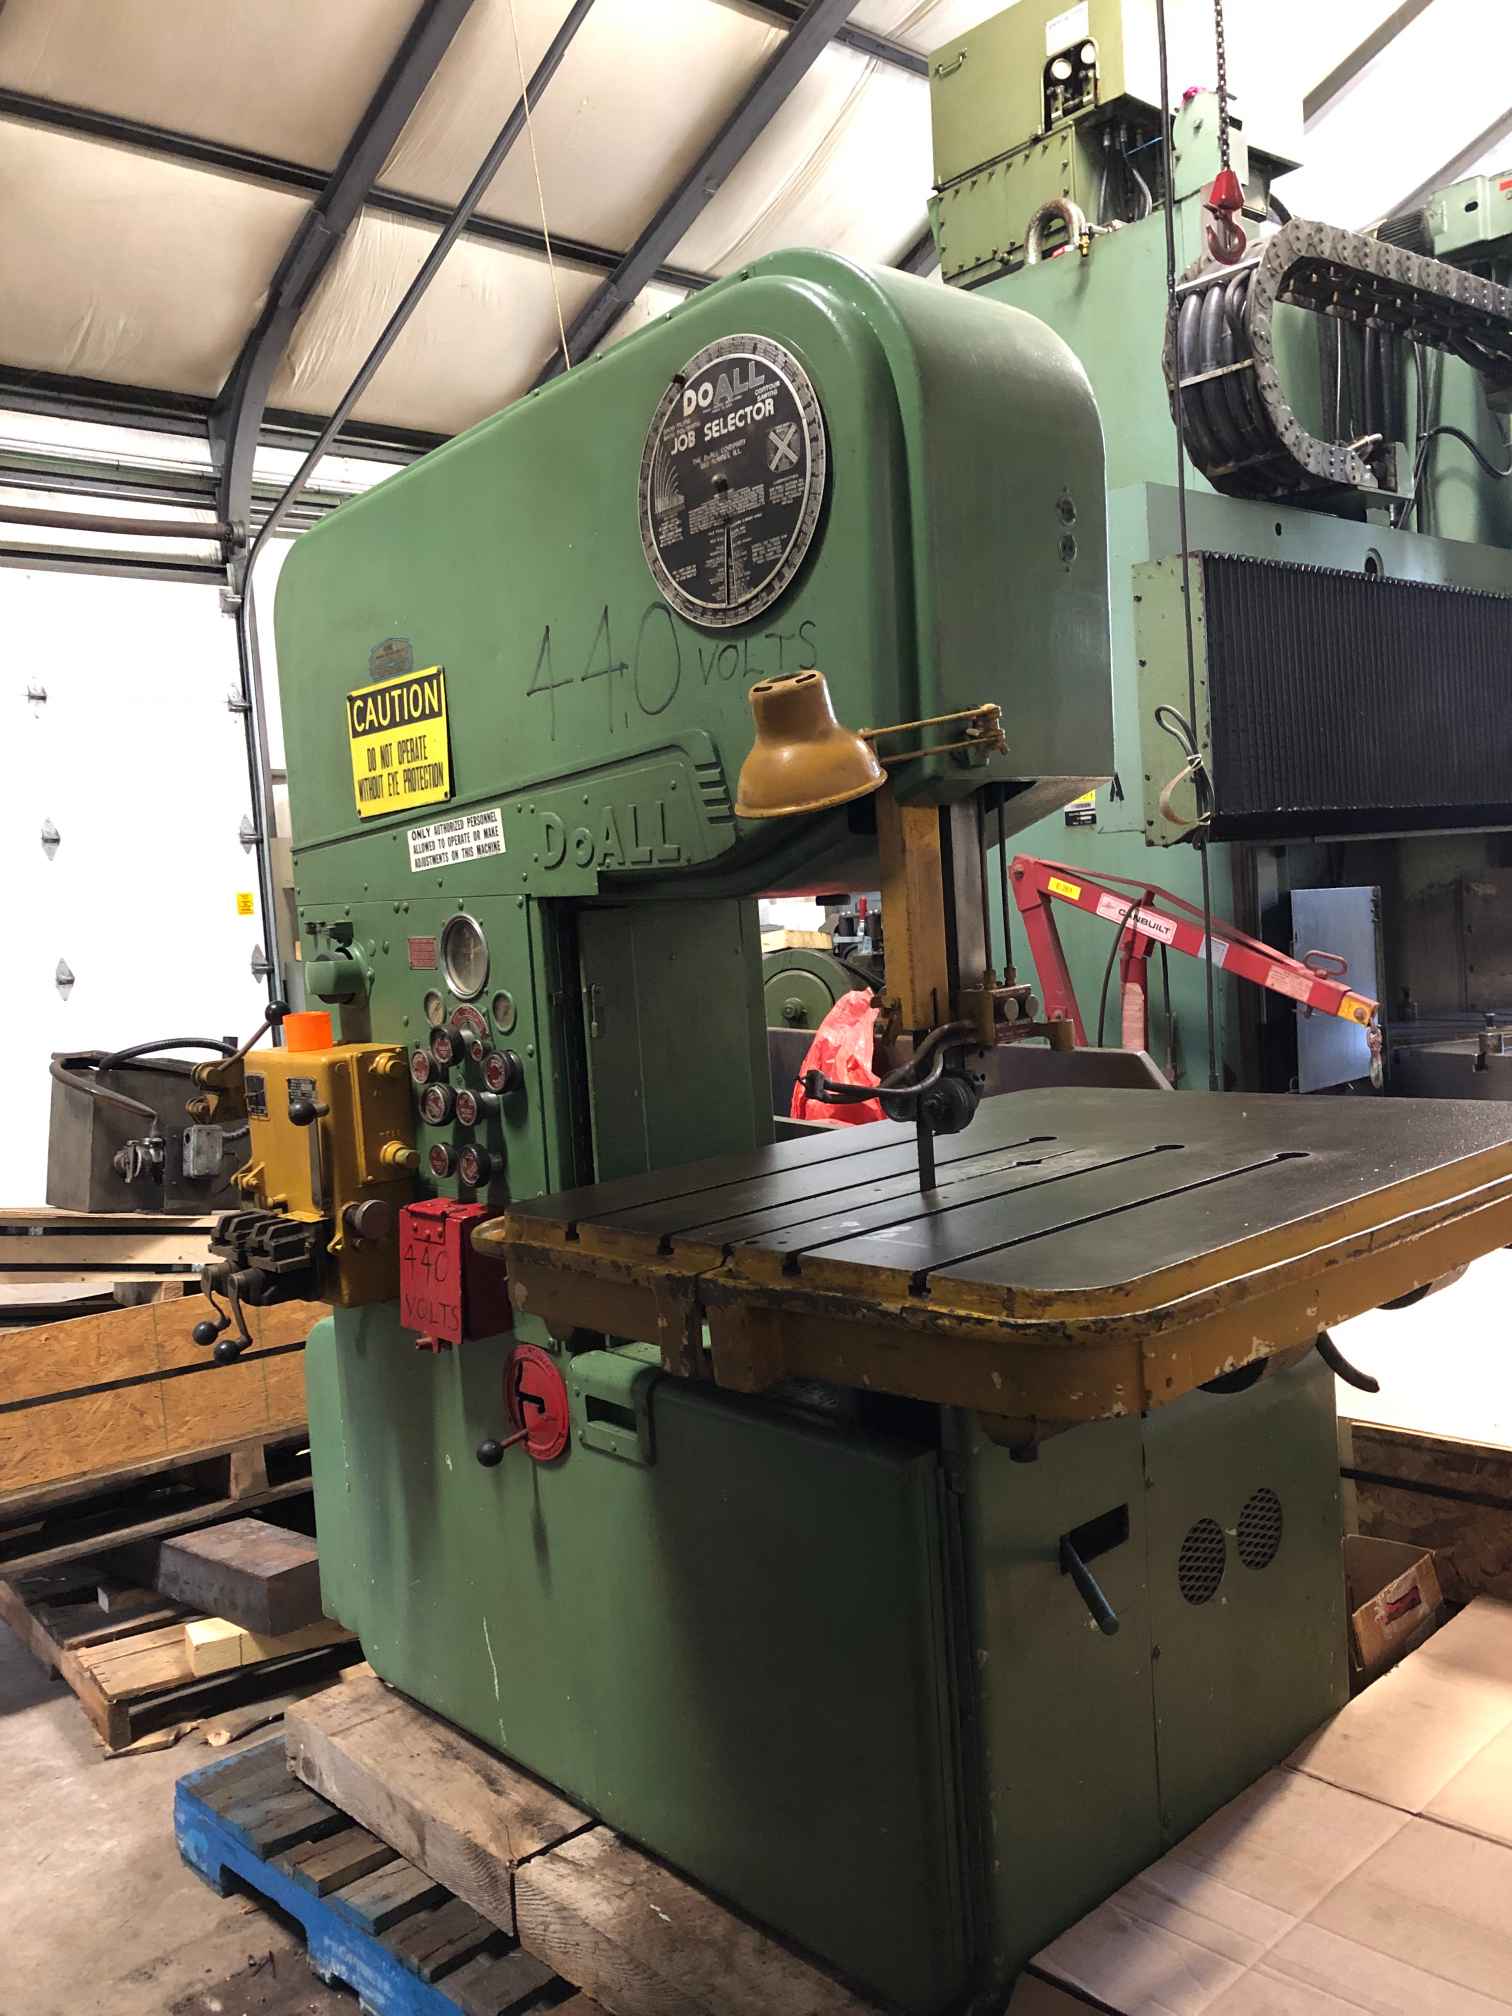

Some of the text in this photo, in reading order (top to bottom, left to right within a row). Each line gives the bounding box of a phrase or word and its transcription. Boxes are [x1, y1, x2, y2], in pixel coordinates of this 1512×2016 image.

[670, 430, 696, 456] JOB
[703, 398, 775, 442] SELECTOR
[526, 601, 682, 741] 440
[698, 620, 818, 686] VOLTS
[353, 679, 439, 732] CAUTION
[367, 735, 428, 772] DO NOT OPERATE
[358, 762, 445, 802] WITHOUT EYE PROTECTION
[411, 811, 498, 841] ONLY AUTHORIZED PERSONNEL
[413, 825, 499, 855] ALLOWED TO OPERATE OR MAKE
[414, 840, 501, 869] ADJUSTMENTS ON THIS MACHINE
[404, 1243, 449, 1286] 440
[405, 1294, 460, 1331] VOLTS
